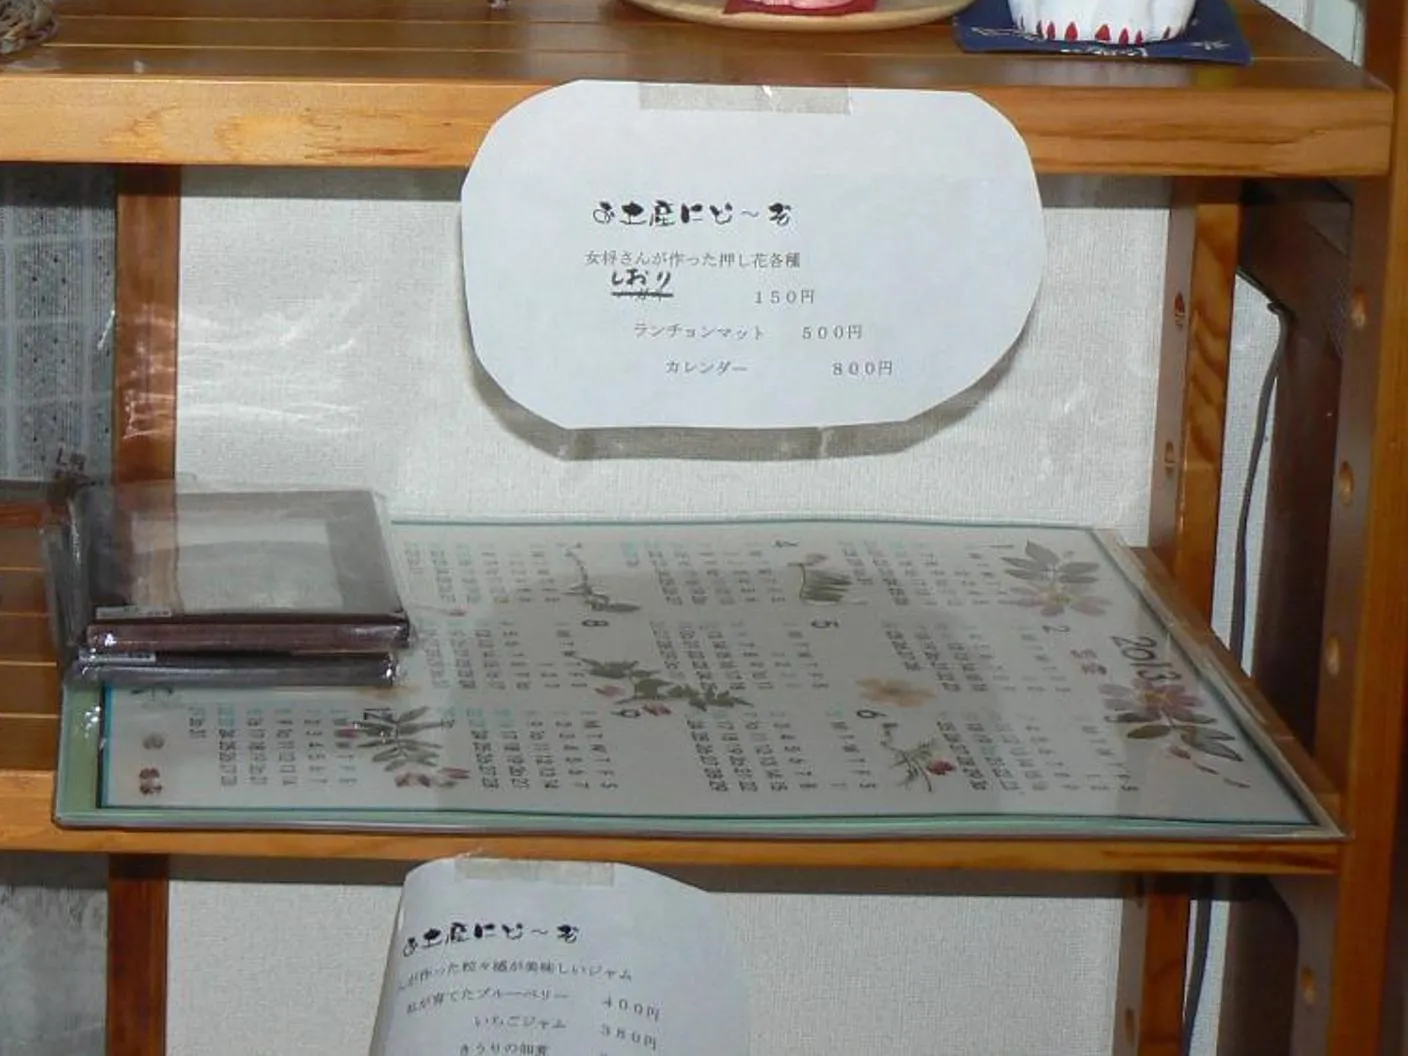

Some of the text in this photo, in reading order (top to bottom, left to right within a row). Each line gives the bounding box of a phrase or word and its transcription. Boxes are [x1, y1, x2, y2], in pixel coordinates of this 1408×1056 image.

[632, 322, 765, 341] ランチョンマット
[664, 359, 748, 375] カレンダー
